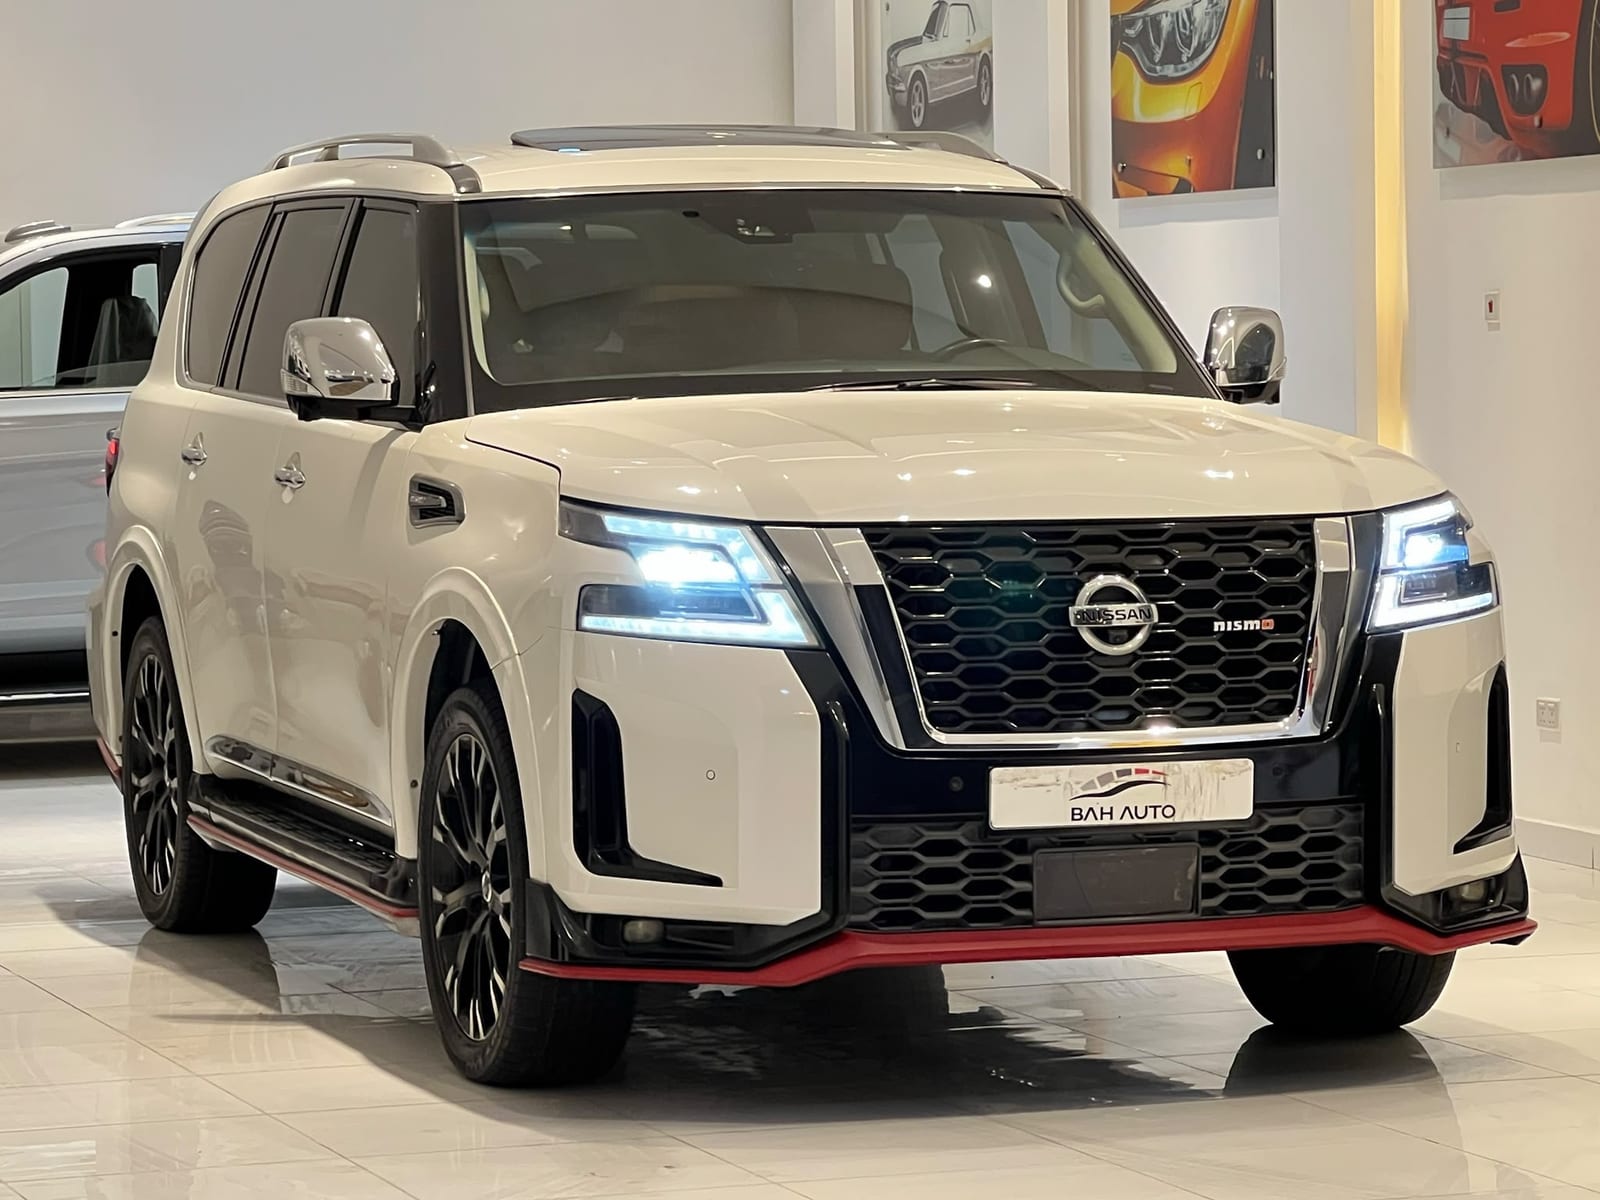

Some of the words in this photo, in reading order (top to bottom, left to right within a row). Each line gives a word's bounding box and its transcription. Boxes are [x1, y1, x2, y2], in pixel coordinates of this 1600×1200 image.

[1081, 608, 1152, 622] NISSAN
[1071, 806, 1113, 821] BAH
[1119, 804, 1176, 820] AUTO
